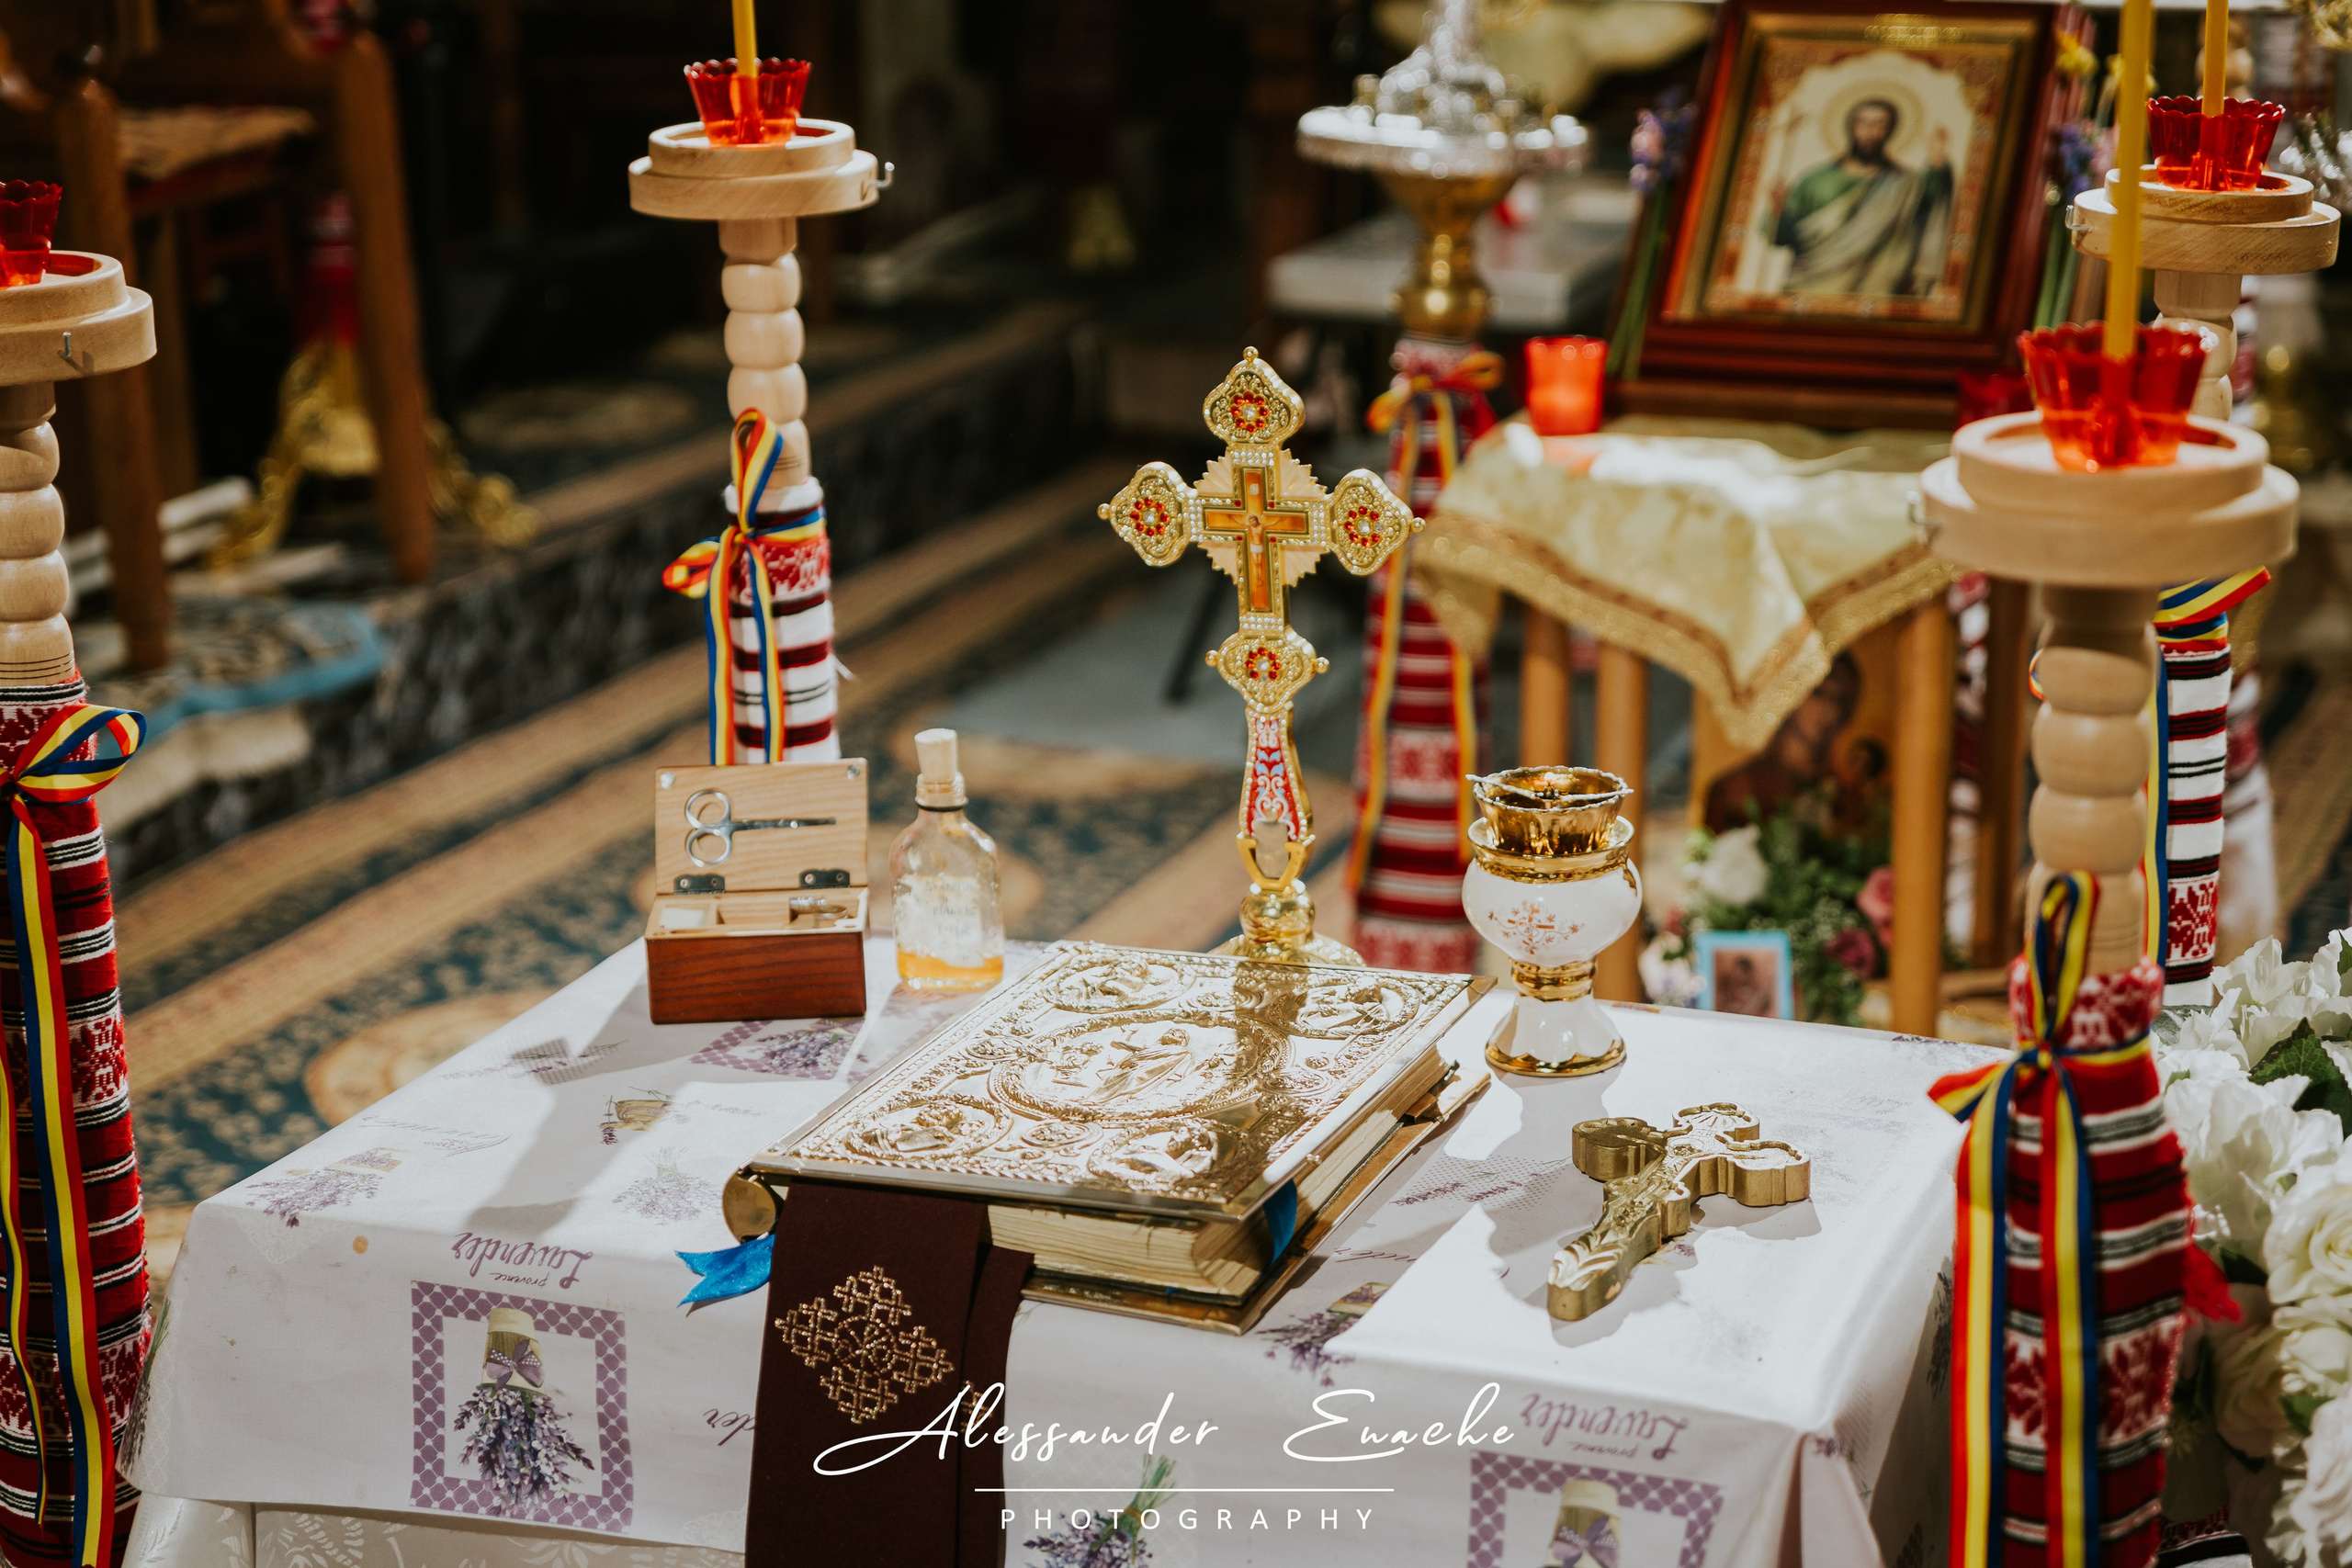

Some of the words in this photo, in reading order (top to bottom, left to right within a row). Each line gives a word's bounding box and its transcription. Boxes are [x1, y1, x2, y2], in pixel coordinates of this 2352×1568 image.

[451, 1232, 594, 1290] Lavender
[488, 1272, 549, 1289] provence
[702, 1408, 756, 1447] der
[1520, 1393, 1689, 1461] Lavender
